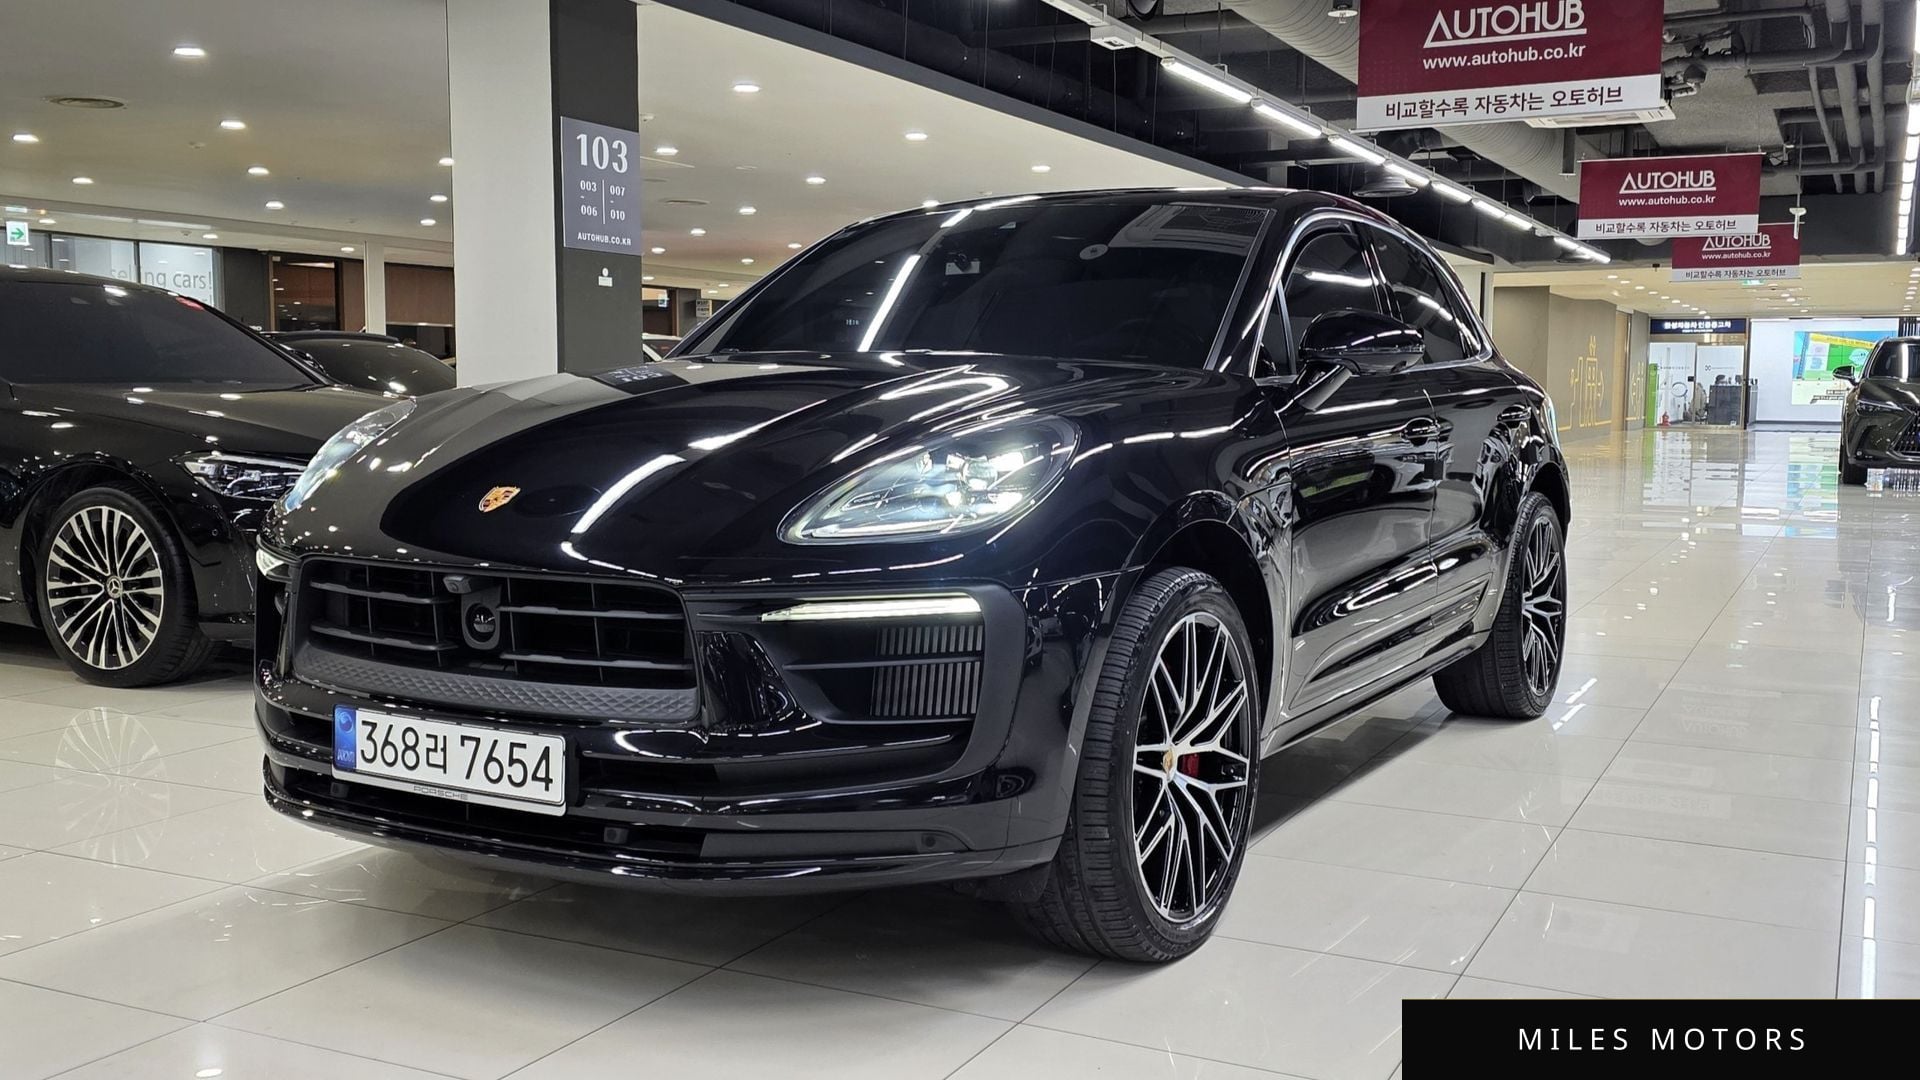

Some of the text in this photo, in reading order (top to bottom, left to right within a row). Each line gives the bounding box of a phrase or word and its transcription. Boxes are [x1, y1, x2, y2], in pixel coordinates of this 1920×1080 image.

[1423, 0, 1587, 48] AUTOHUB
[1423, 42, 1586, 70] www.autohub.co.kr
[1385, 86, 1623, 121] 비교할수록 자동차는 오토허브
[576, 133, 628, 174] 103
[580, 179, 597, 192] 003
[1619, 169, 1716, 194] AUTOHUB
[609, 185, 626, 197] 007
[1618, 194, 1716, 207] www.autohub.co.kr
[580, 204, 598, 217] 006
[610, 209, 626, 221] 010
[1595, 219, 1737, 234] 비교할수록 자동차는 오토허브
[577, 231, 632, 246] AUTOHUB.CO.KR
[1702, 233, 1772, 251] AUTOHUB
[1701, 250, 1771, 260] www.autohub.co.kr
[172, 271, 213, 290] cars!
[360, 719, 554, 792] 368러 7654
